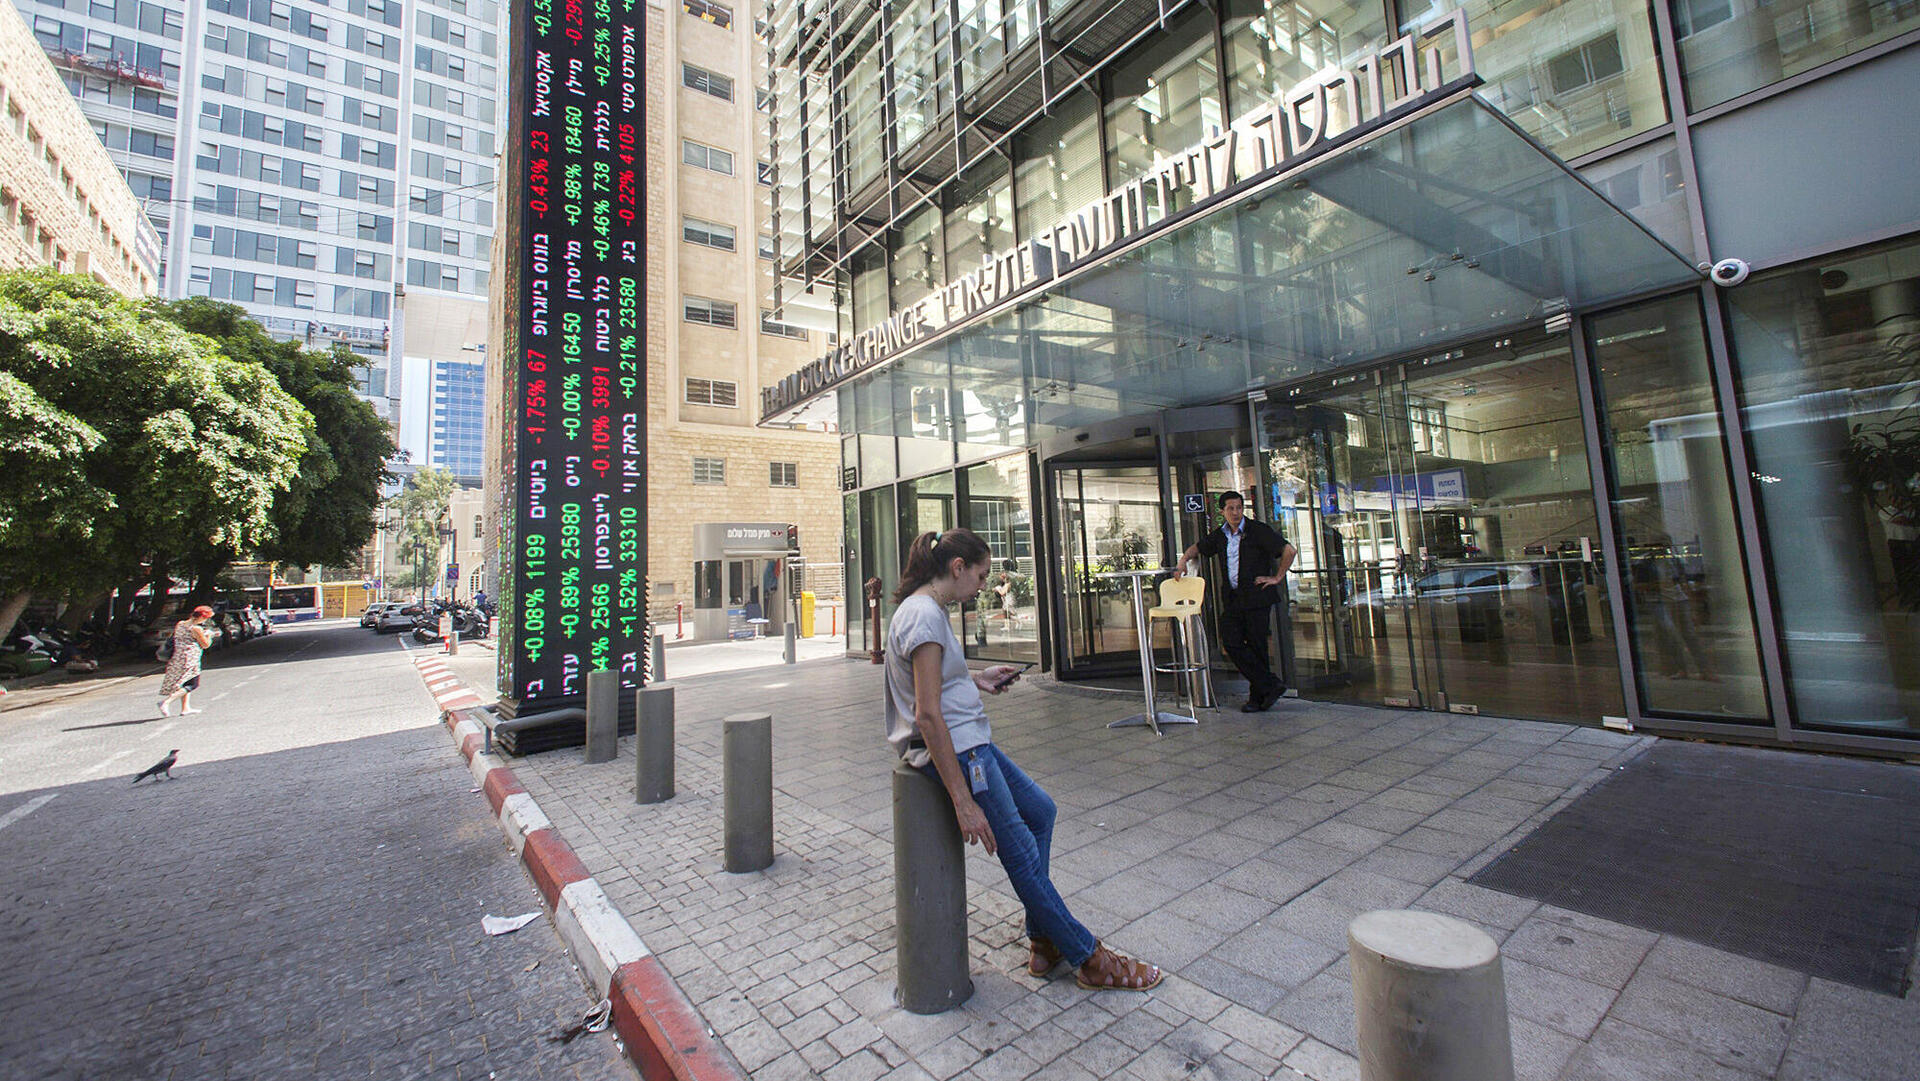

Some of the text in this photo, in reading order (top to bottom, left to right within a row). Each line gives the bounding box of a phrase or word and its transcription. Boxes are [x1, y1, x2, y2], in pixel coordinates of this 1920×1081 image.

[565, 58, 585, 96] מיילן
[594, 29, 610, 86] +0.25%
[622, 25, 635, 78] ארפורט
[532, 50, 554, 117] אקסטיאל
[622, 82, 635, 112] סיטי
[1252, 8, 1475, 172] הבורסה
[531, 131, 549, 152] 23
[565, 106, 582, 154] 18460
[593, 101, 609, 151] כלכלית
[619, 124, 634, 164] 4105
[530, 159, 548, 218] -0.43%
[564, 164, 582, 226] +0.98%
[593, 162, 610, 191] 738
[619, 171, 635, 226] -0.22%
[1099, 125, 1238, 250] לניירות
[533, 233, 548, 273] בונוס
[593, 200, 610, 261] +0.46%
[622, 240, 635, 263] ביג
[1041, 205, 1098, 280] ערך
[563, 241, 584, 300] מליסרון
[592, 276, 609, 301] כלל
[532, 279, 548, 335] ביוגרופ
[595, 308, 609, 352] ביטוח
[619, 278, 636, 328] 23580
[528, 349, 546, 372] 67
[562, 313, 581, 364] 16450
[801, 347, 845, 397] STOCK
[841, 301, 927, 375] EXCHANGE
[592, 367, 610, 408] 3991
[619, 336, 636, 399] +0.21%
[527, 380, 546, 444] -1.75%
[562, 374, 581, 440] +0.00%
[622, 413, 640, 455] בראק
[566, 456, 580, 486] נייס
[592, 416, 610, 478] -0.10%
[530, 459, 546, 519] ביוטיים
[526, 535, 545, 579] 1199
[561, 503, 580, 559] 25980
[592, 493, 613, 569] לייבפרסון
[619, 508, 637, 561] 33310
[525, 589, 545, 662] +0.08%
[560, 567, 580, 638] +0.89%
[591, 584, 610, 629] 2566
[619, 569, 637, 637] +1.52%
[622, 652, 636, 672] גב
